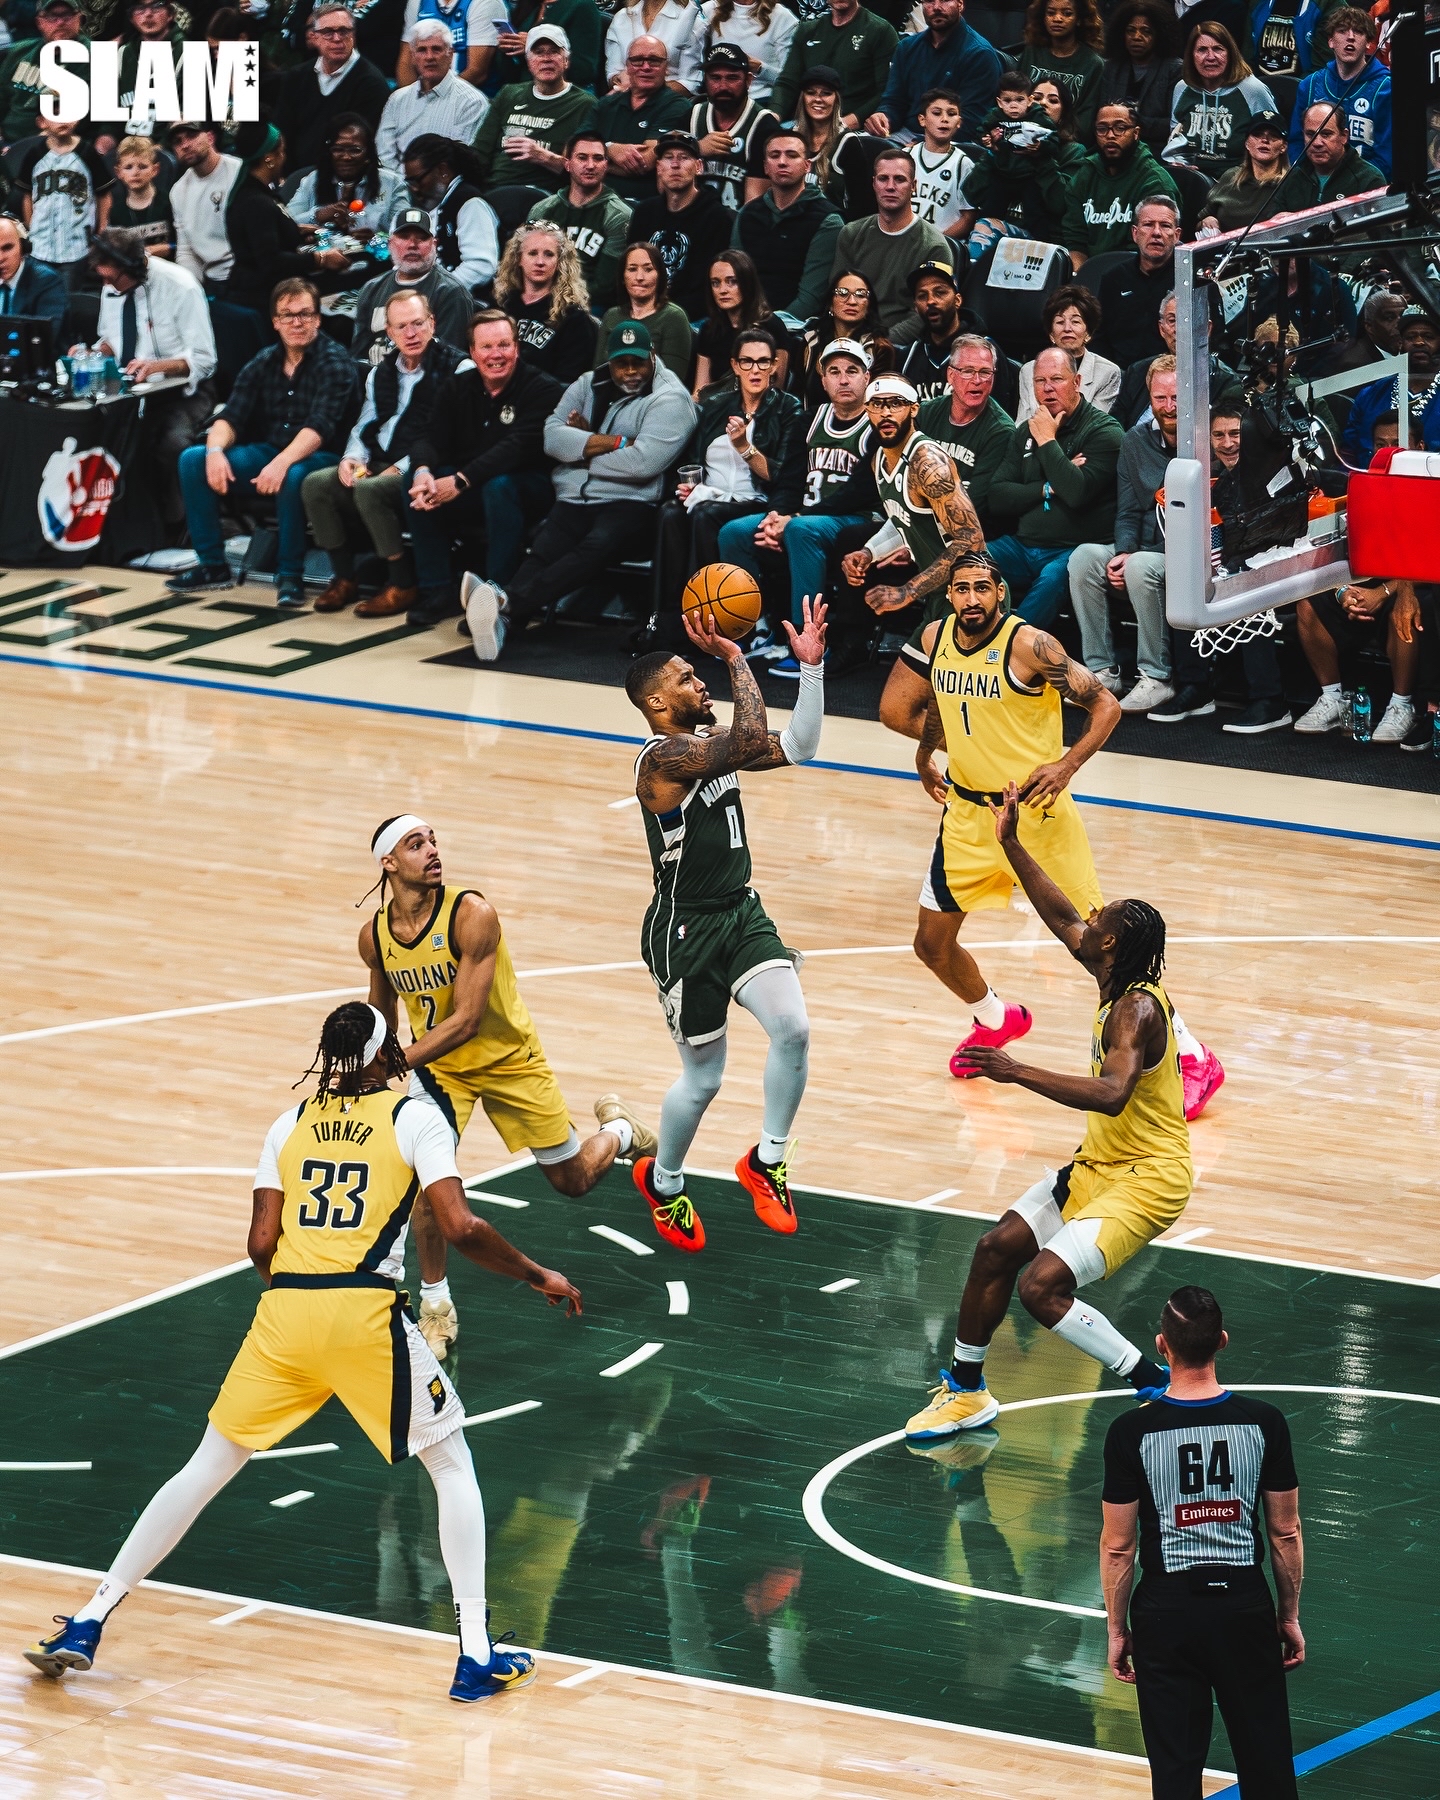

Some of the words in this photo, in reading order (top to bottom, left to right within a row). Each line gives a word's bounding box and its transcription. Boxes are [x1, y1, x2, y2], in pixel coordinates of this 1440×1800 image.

[911, 182, 951, 207] CKS
[566, 226, 605, 258] CKS
[933, 667, 1003, 700] INDIANA
[959, 700, 973, 737] 1
[724, 805, 744, 849] 0
[419, 994, 438, 1031] 2
[310, 1119, 375, 1147] TURNER
[298, 1157, 370, 1231] 33
[1177, 1439, 1236, 1496] 64
[1181, 1506, 1235, 1521] Emirates
